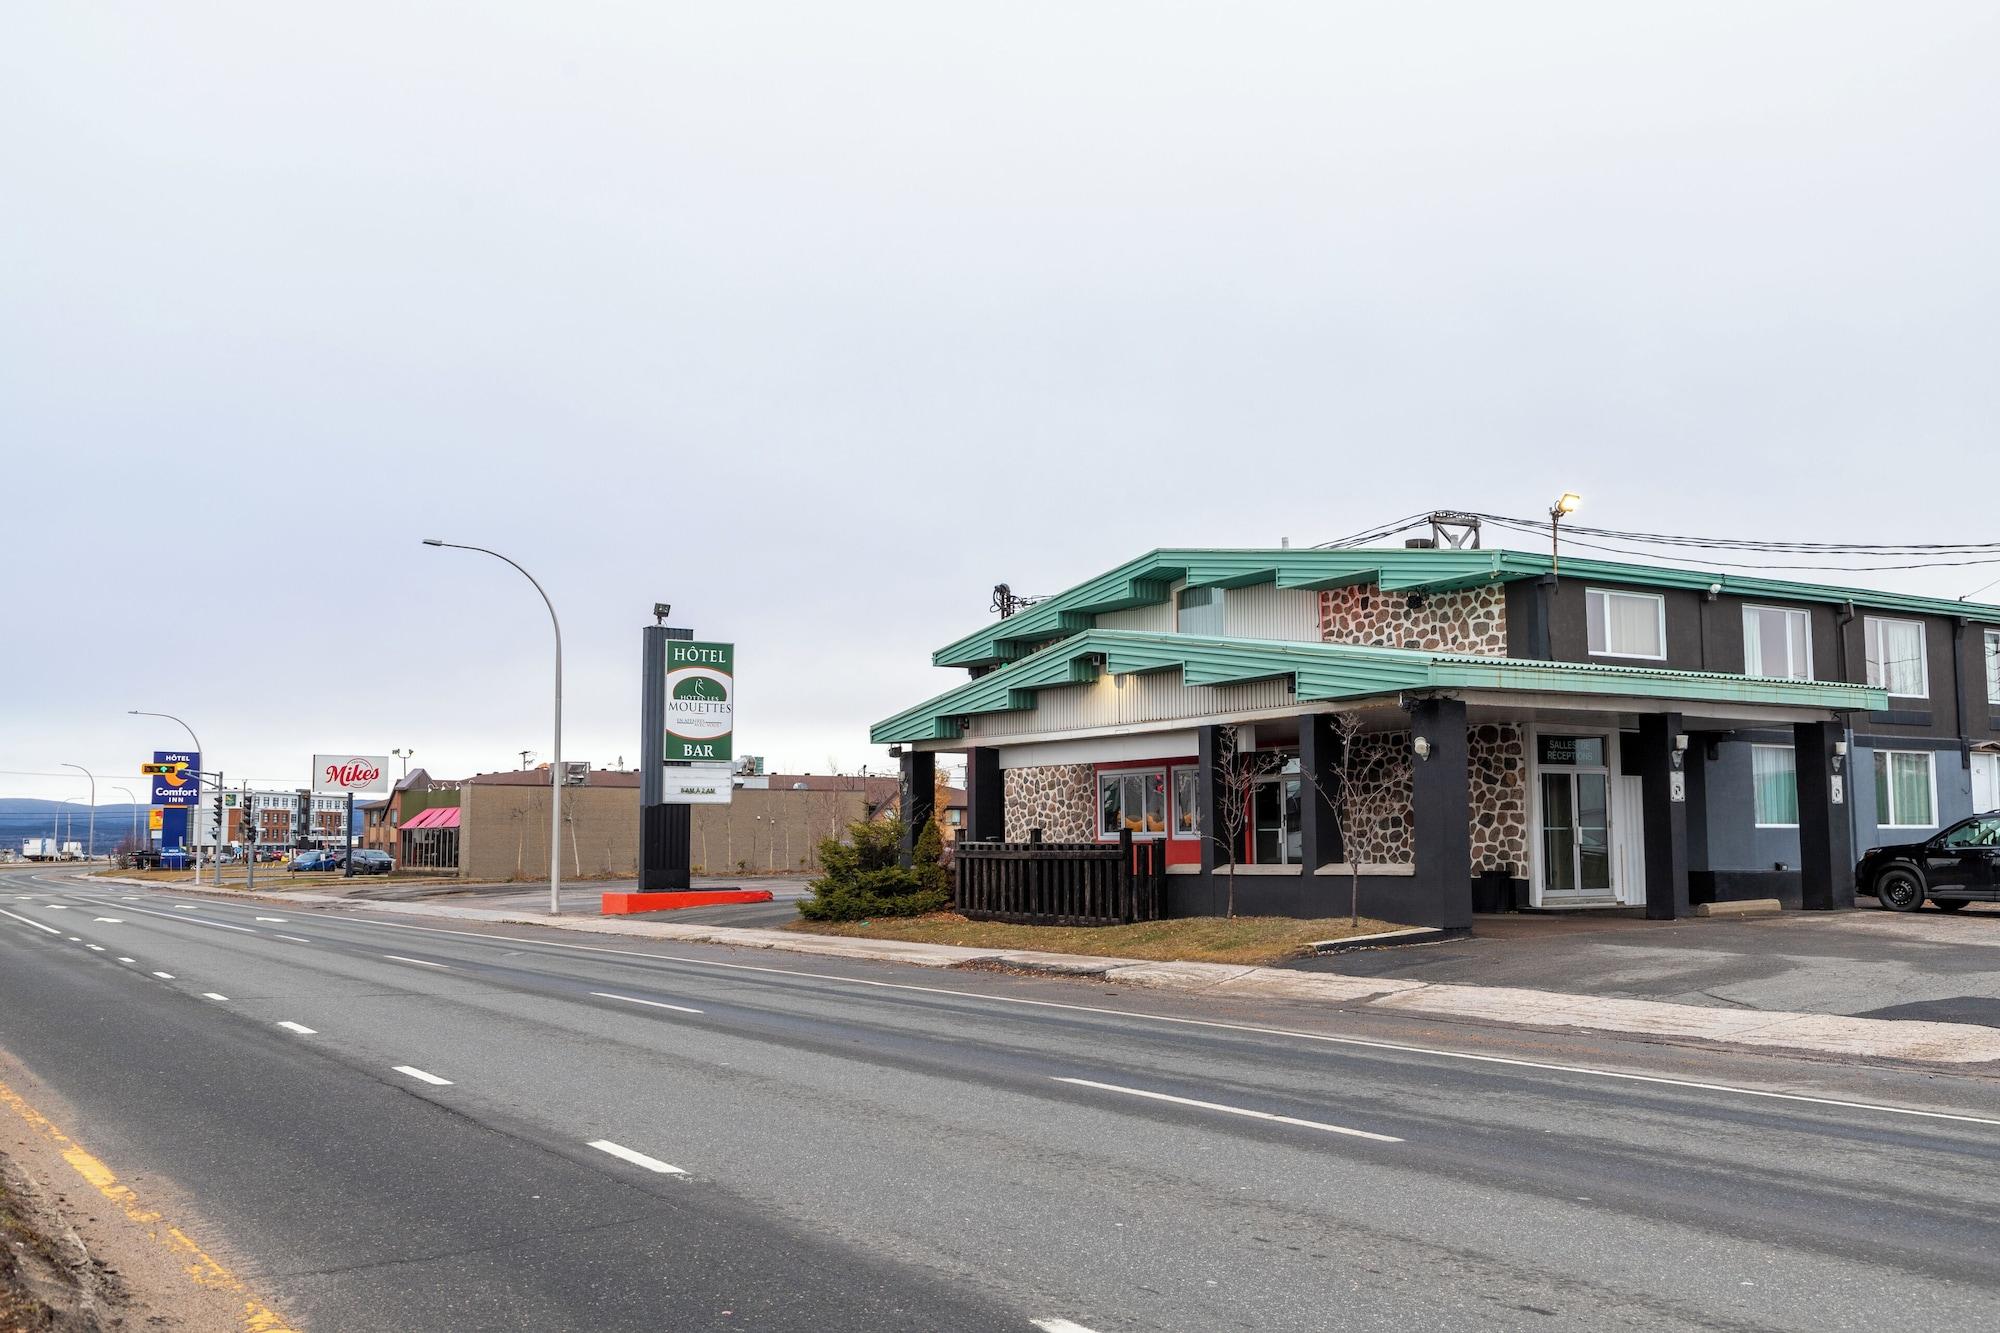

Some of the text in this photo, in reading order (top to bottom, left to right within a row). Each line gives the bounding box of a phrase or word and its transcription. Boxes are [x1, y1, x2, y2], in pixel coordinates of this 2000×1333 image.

[674, 646, 726, 663] HÔTEL
[668, 702, 732, 714] MOUETTES
[683, 744, 714, 757] BAR
[1550, 740, 1576, 750] SALLES
[326, 764, 379, 786] Mikes
[156, 788, 197, 797] Comfort
